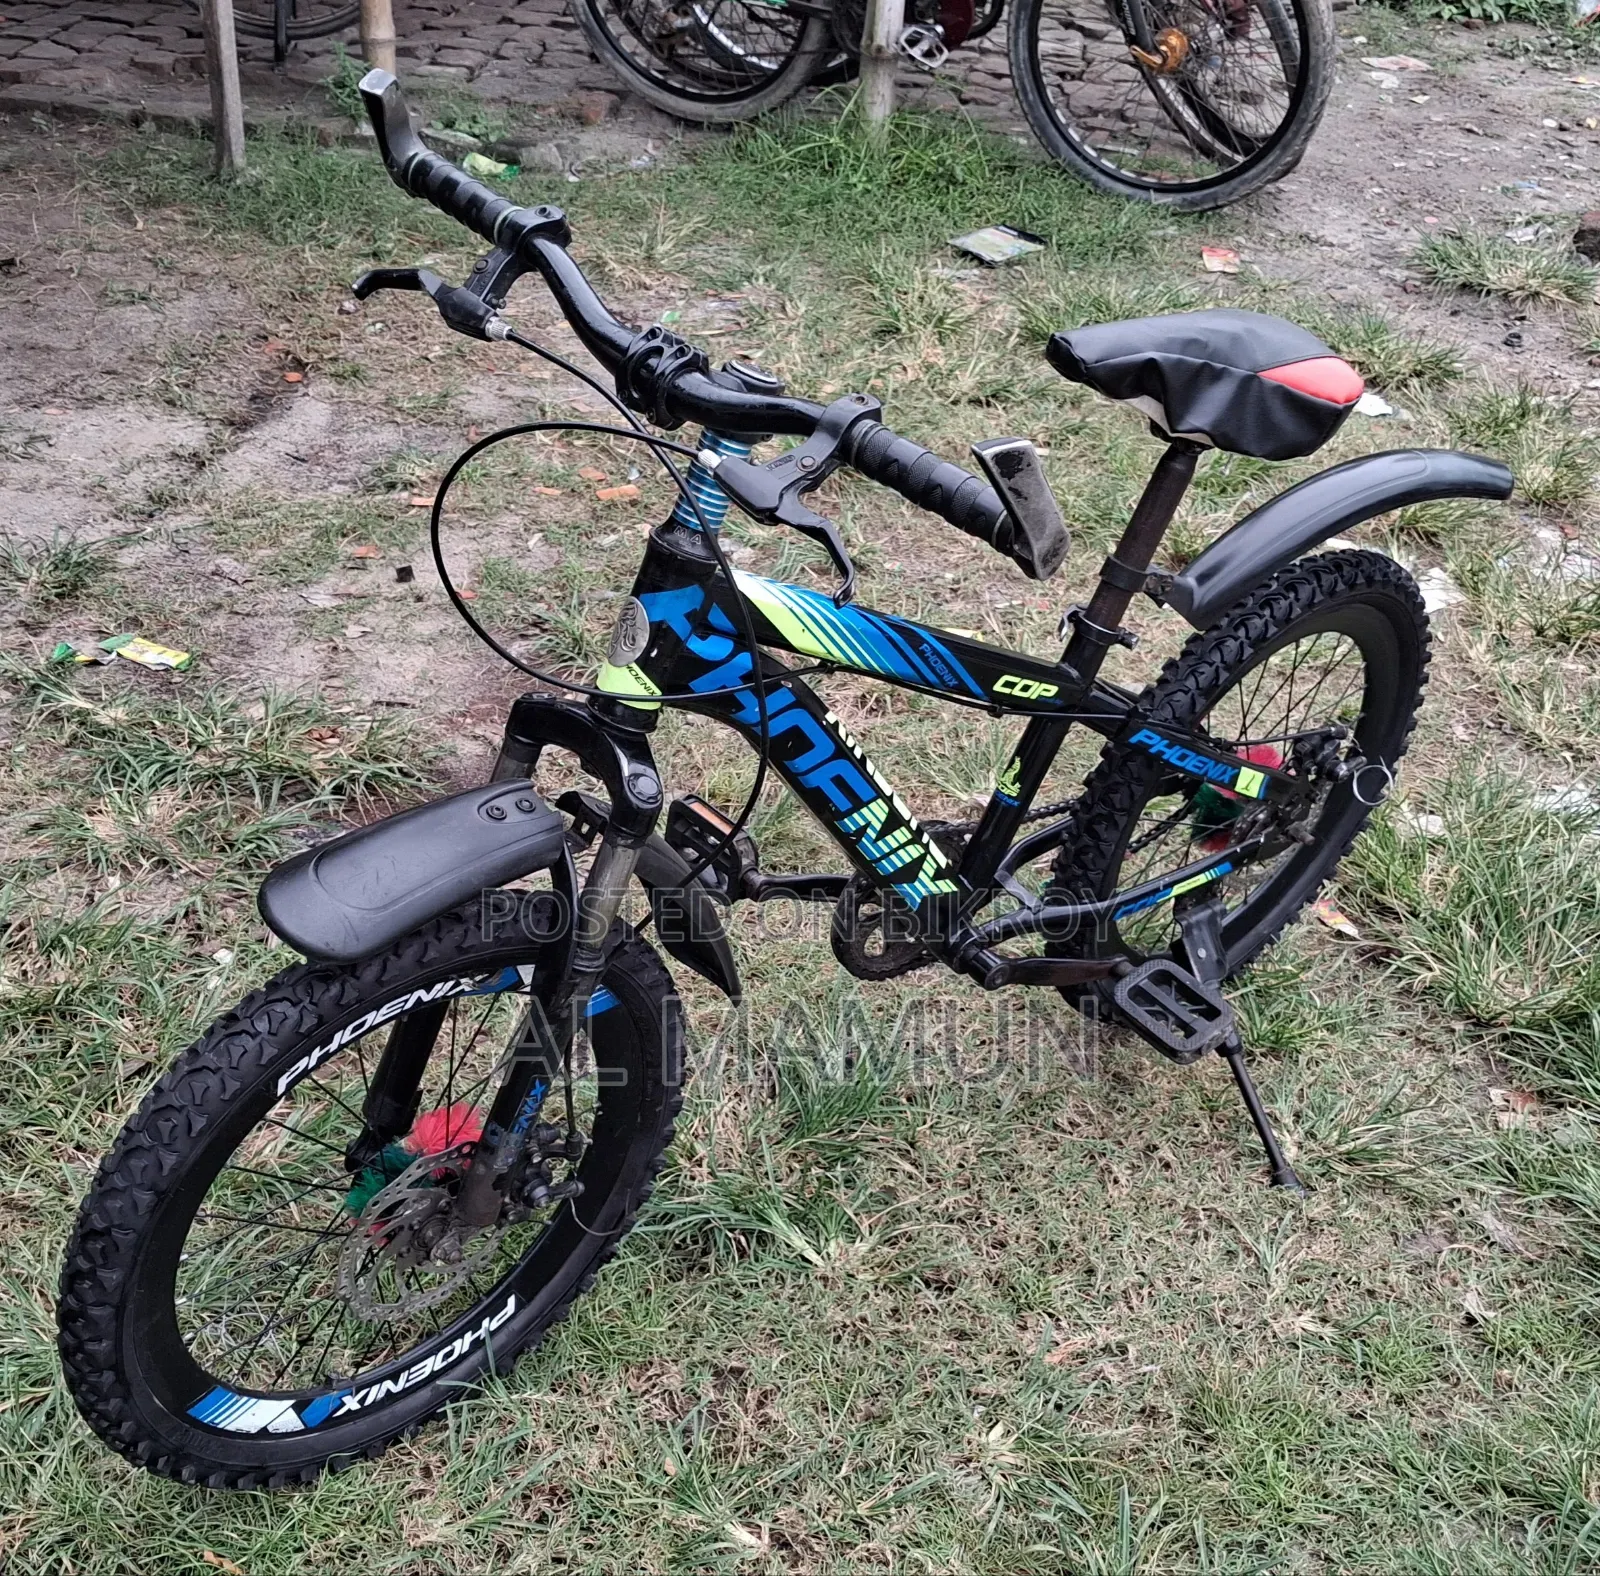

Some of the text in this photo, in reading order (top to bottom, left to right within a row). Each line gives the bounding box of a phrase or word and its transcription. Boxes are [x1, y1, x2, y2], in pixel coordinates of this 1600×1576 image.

[626, 662, 658, 698] HOENIX
[918, 643, 959, 688] PHOENIX
[992, 674, 1059, 700] COP
[1128, 728, 1239, 784] PHOENIX
[276, 973, 490, 1097] PHOENIX
[332, 1293, 516, 1418] PHOENIX
